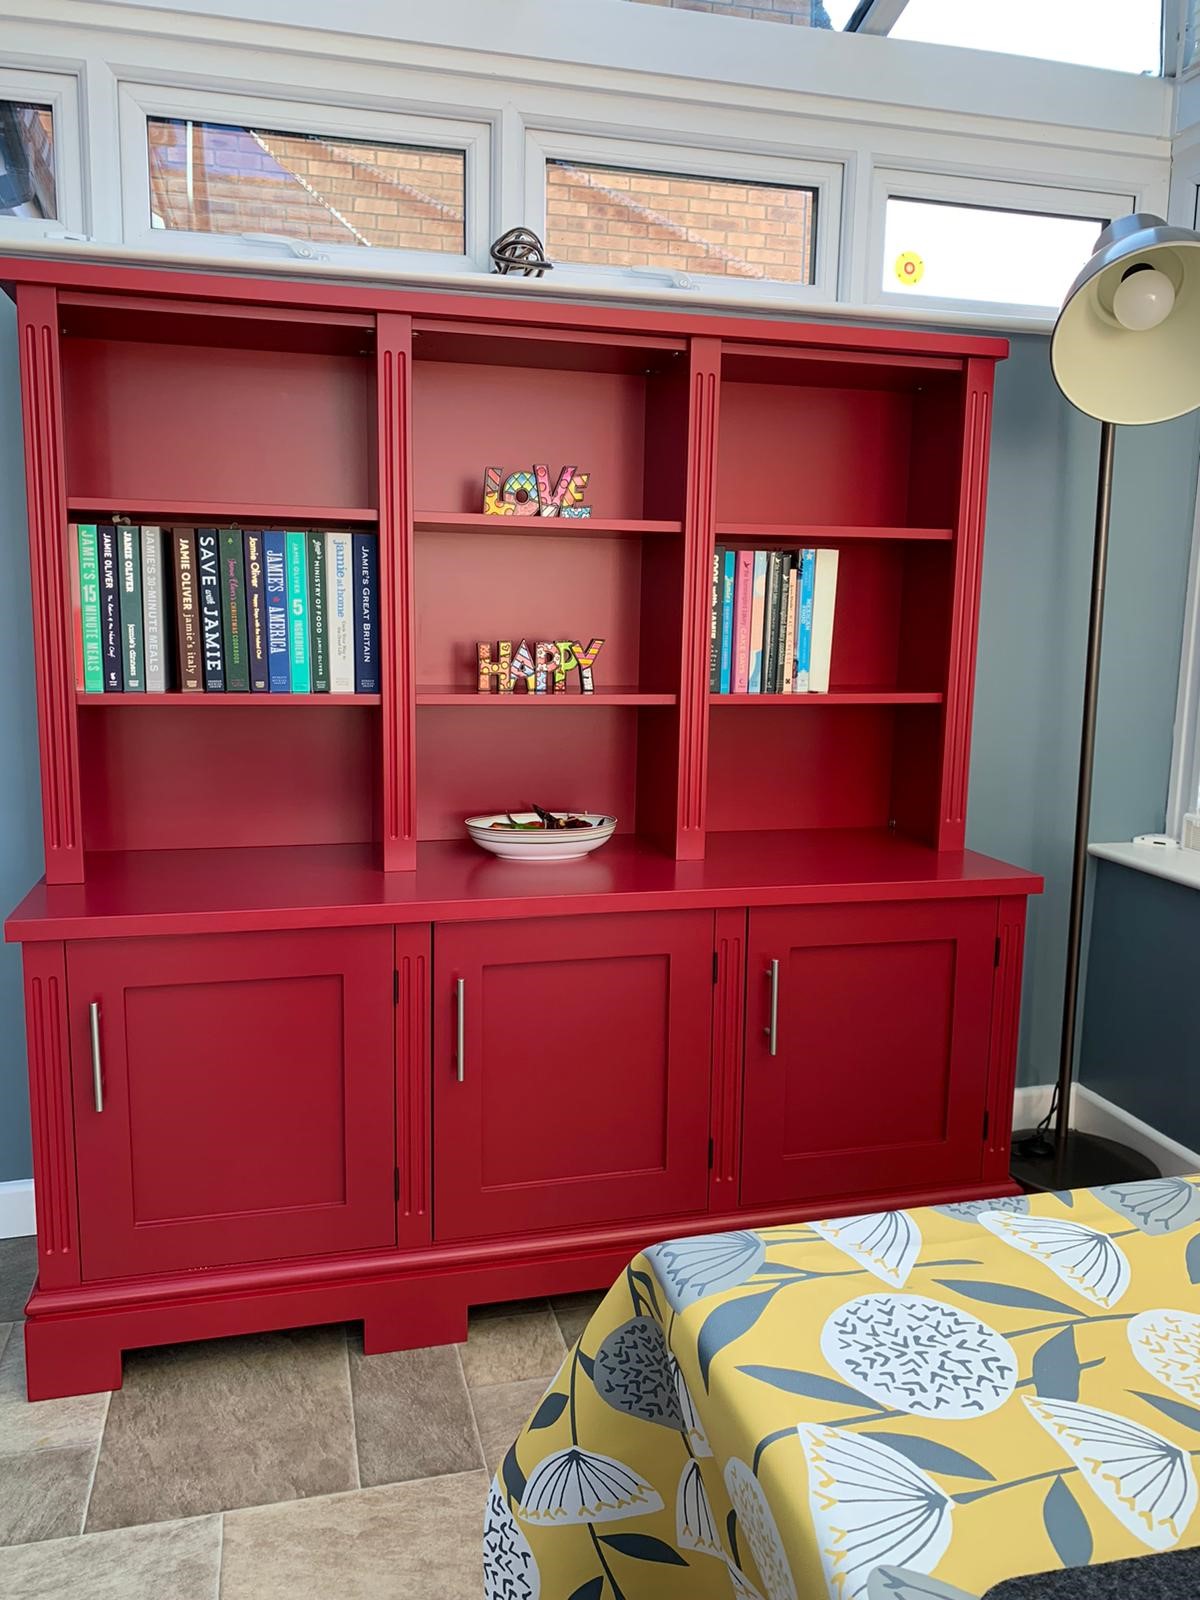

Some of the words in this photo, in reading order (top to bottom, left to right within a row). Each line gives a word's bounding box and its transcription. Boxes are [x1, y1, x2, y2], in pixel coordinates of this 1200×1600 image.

[483, 464, 592, 518] LOVE
[81, 530, 96, 580] JAMIE'S
[103, 533, 113, 558] JAMIE
[123, 531, 133, 560] JAMIE
[145, 530, 157, 574] JAMIE'S
[179, 538, 191, 570] JAMIE
[199, 536, 217, 586] SAVE
[249, 536, 259, 561] Jamie
[292, 543, 300, 565] JAMIE
[333, 539, 348, 578] jamie
[104, 560, 113, 588] OLIVER
[124, 560, 134, 592] OLIVER
[250, 562, 261, 588] Oliver
[267, 549, 285, 593] JAMIE'S
[293, 566, 301, 594] OLIVER
[313, 560, 321, 597] MINISTRY
[361, 545, 370, 585] JAMIE'S
[83, 584, 96, 601] 15
[146, 576, 158, 632] 30-MINUTE
[181, 572, 193, 610] OLIVER
[292, 598, 303, 616] 5
[315, 598, 322, 610] OF
[337, 588, 347, 618] home
[362, 587, 371, 620] GREAT
[84, 605, 98, 639] MINUTE
[127, 623, 136, 648] jamie's
[183, 613, 196, 649] jamie's
[268, 606, 286, 654] AMERICA
[148, 635, 159, 673] MEALS
[203, 607, 221, 671] JAMIE
[362, 623, 371, 663] BRITAIN
[86, 642, 100, 672] MEALS
[129, 649, 137, 676] dinners
[185, 651, 197, 674] italy
[476, 638, 605, 692] HAPPY
